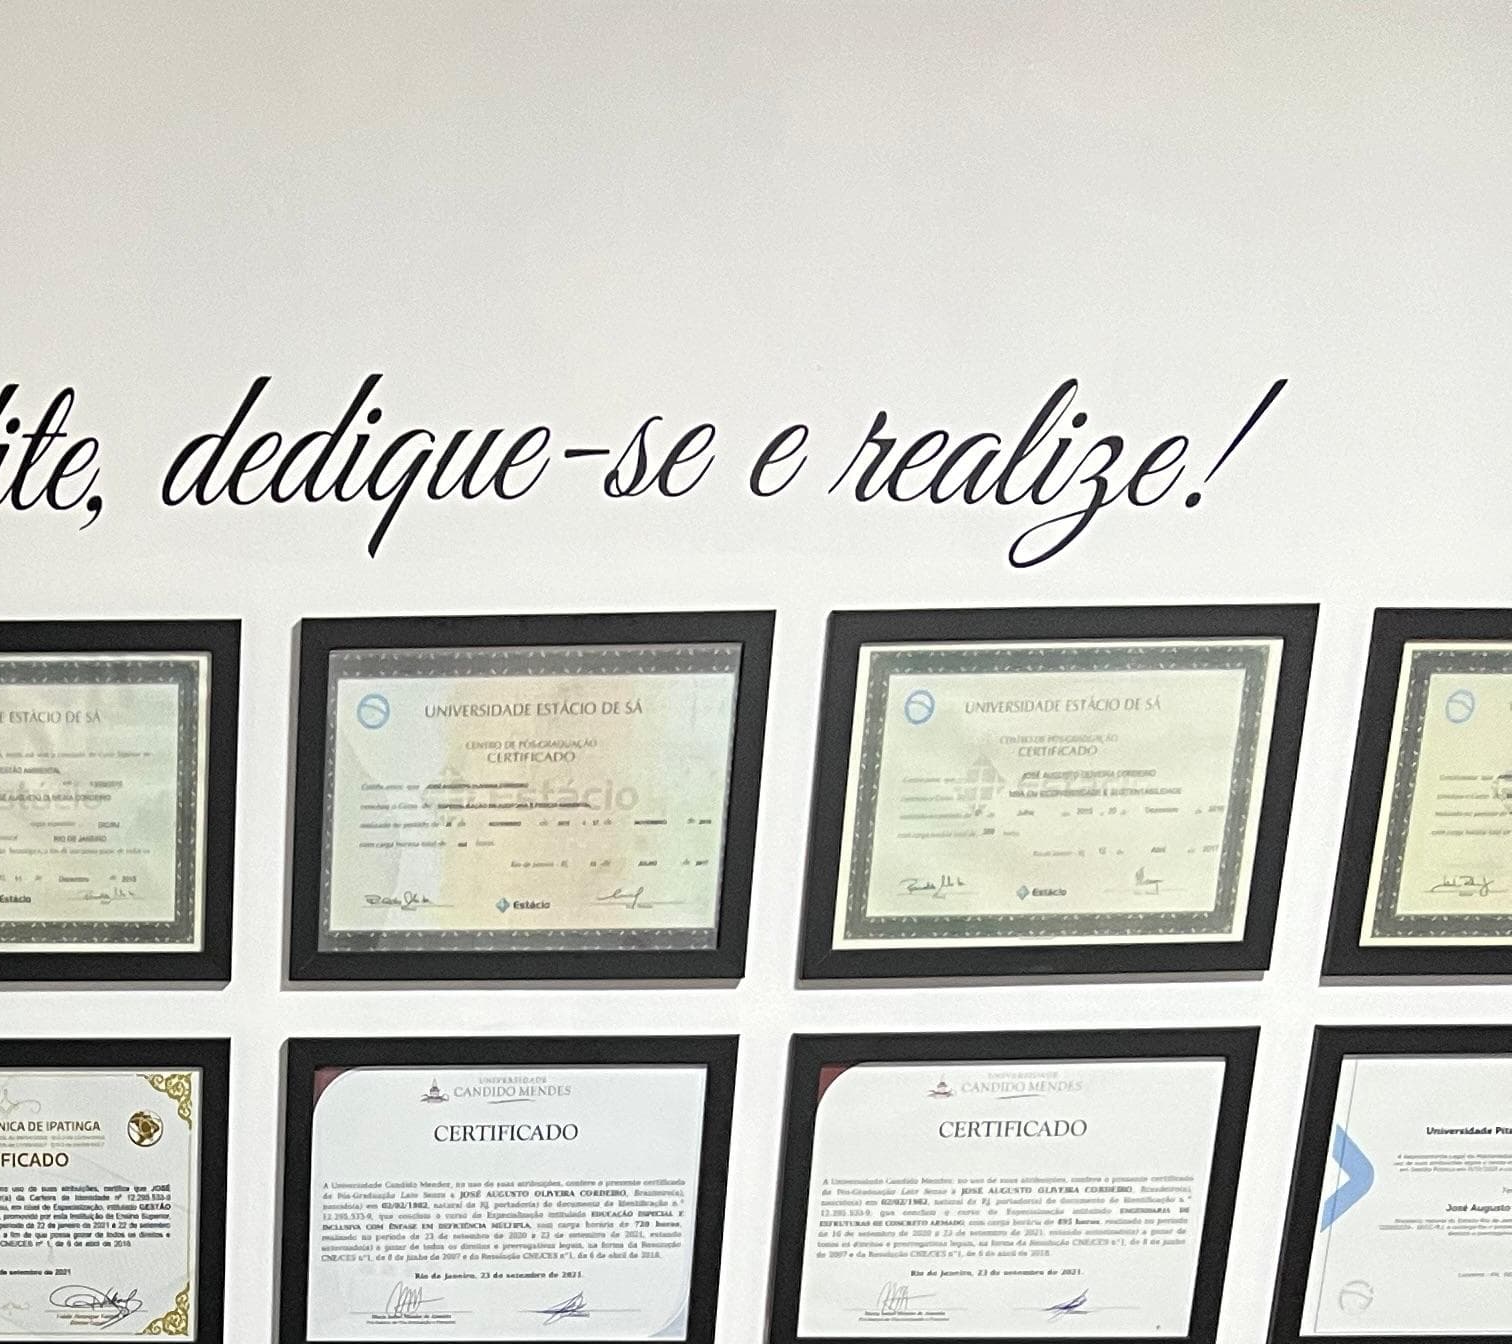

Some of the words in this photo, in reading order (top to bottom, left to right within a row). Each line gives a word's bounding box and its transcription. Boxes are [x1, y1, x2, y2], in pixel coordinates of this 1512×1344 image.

[162, 391, 715, 558] dedique-se
[750, 425, 808, 496] e
[834, 379, 1286, 568] realize!
[425, 703, 531, 718] UNIVERSIDADE
[537, 700, 596, 718] ESTÁCIO
[602, 701, 620, 714] DE
[625, 699, 642, 714] SÁ
[966, 700, 1060, 714] UNIVERSIDADE
[1066, 698, 1120, 712] ESTÁCIO
[1124, 698, 1140, 711] DE
[1145, 696, 1160, 710] SÁ
[9, 710, 61, 725] ESTÁCIO
[66, 711, 81, 723] DE
[86, 710, 100, 723] SÁ
[1018, 746, 1098, 757] CERTIFICADO
[488, 752, 576, 763] CERTIFICADO
[0, 895, 31, 903] Estácio
[514, 901, 550, 909] Estácio
[454, 1087, 516, 1097] CANDIDO
[519, 1086, 571, 1096] MENDES
[961, 1082, 1025, 1092] CANDIDO
[1028, 1080, 1083, 1093] MENDES
[28, 1122, 42, 1131] DE
[46, 1121, 100, 1131] IPATINGA
[940, 1120, 1087, 1138] CERTIFICADO
[434, 1124, 578, 1141] CERTIFICADO
[460, 1191, 481, 1199] JOSÉ
[1470, 1204, 1510, 1213] Augusto
